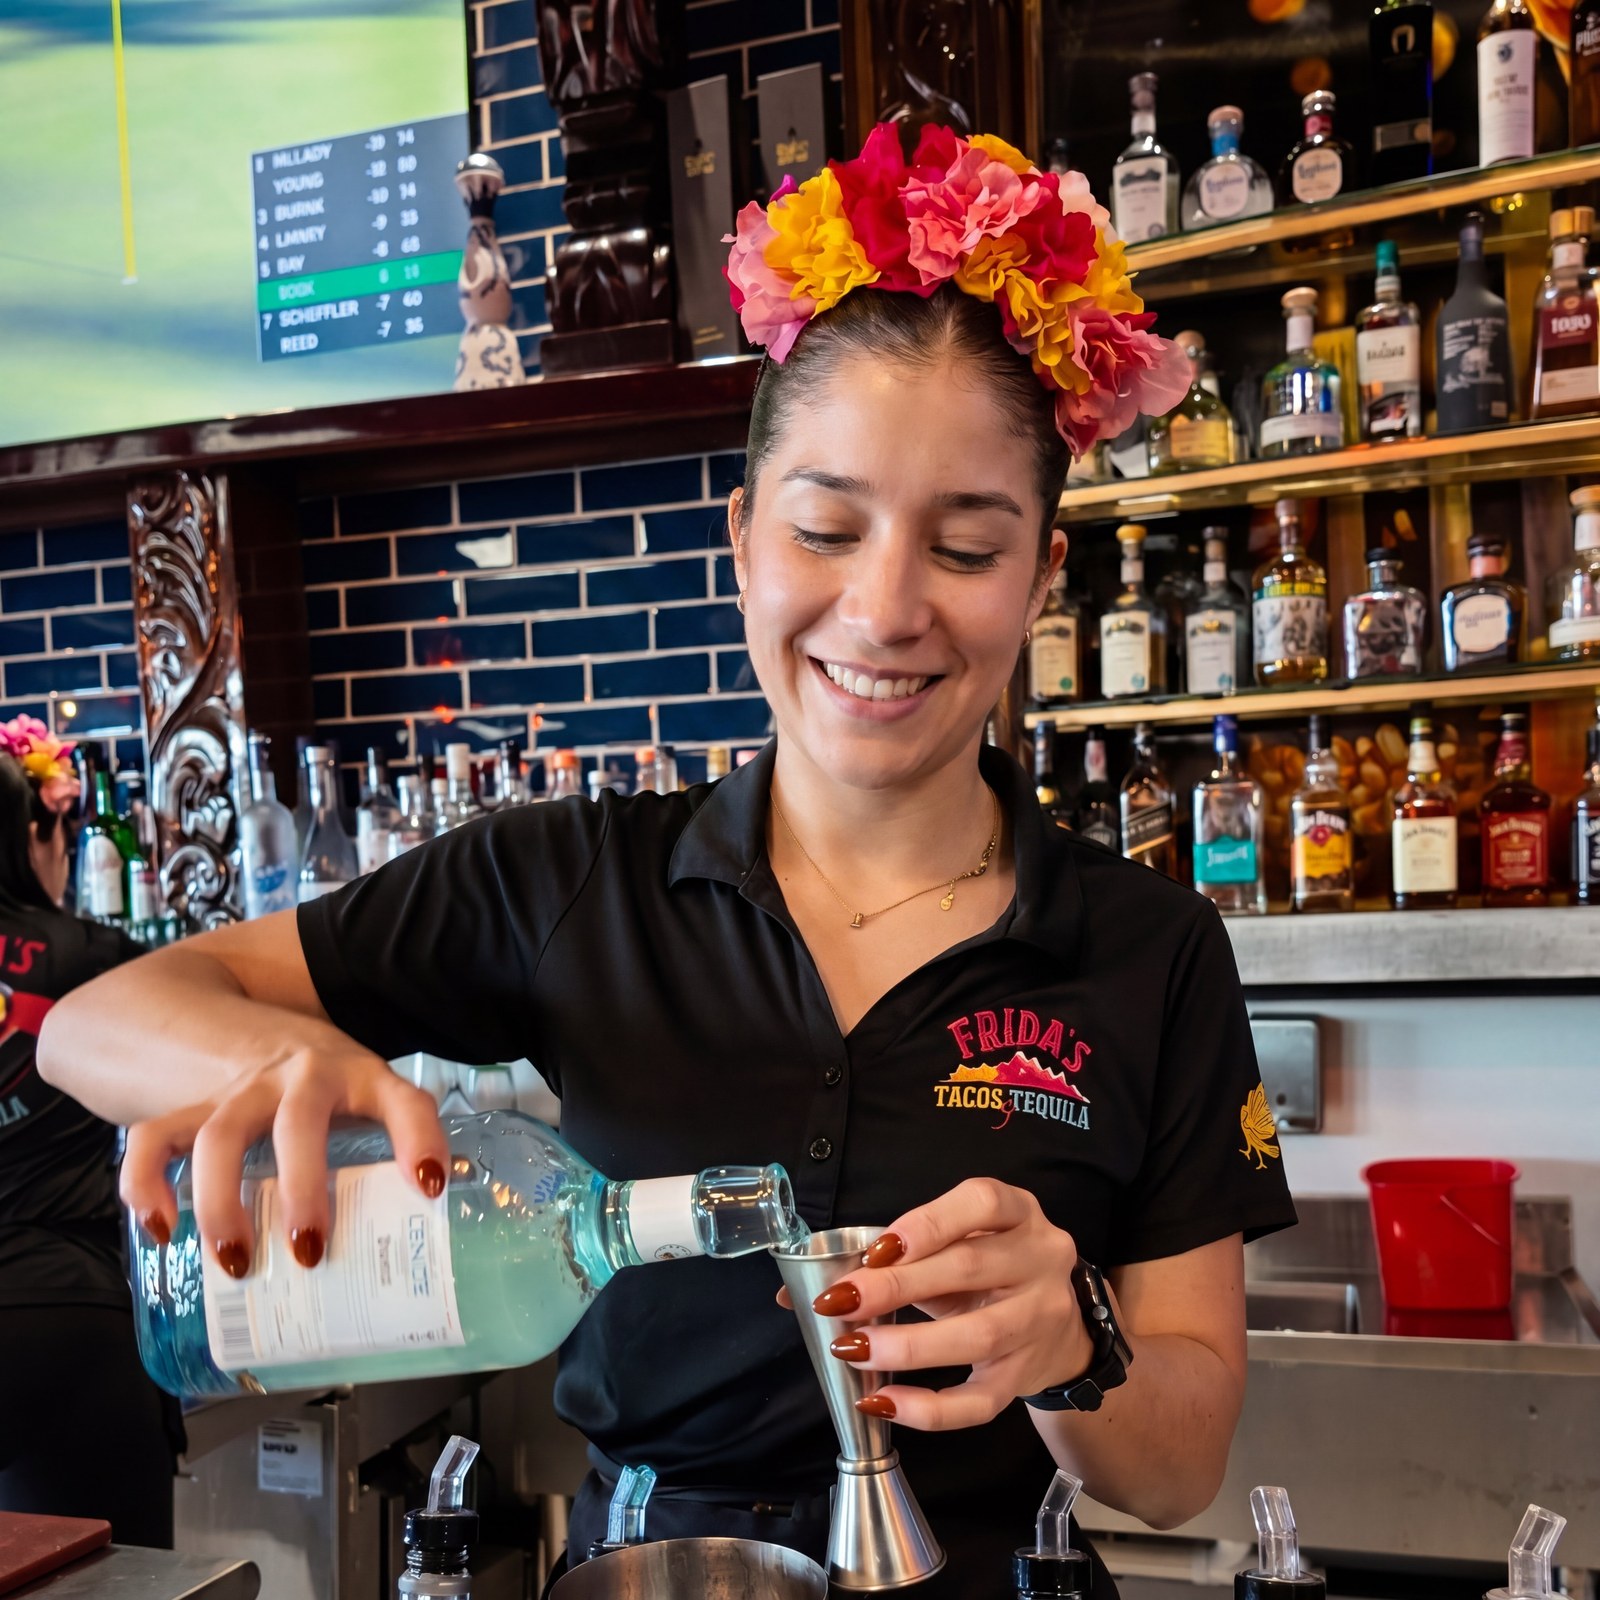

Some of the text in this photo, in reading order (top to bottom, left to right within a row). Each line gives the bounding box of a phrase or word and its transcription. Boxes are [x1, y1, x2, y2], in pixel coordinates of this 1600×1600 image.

[273, 171, 324, 195] YOUNG
[258, 235, 269, 251] 4
[262, 314, 273, 331] 7
[375, 294, 391, 311] -7
[947, 1007, 1092, 1073] FRIDA'S
[934, 1085, 1003, 1110] TACOS
[1009, 1088, 1091, 1130] TEQUILA
